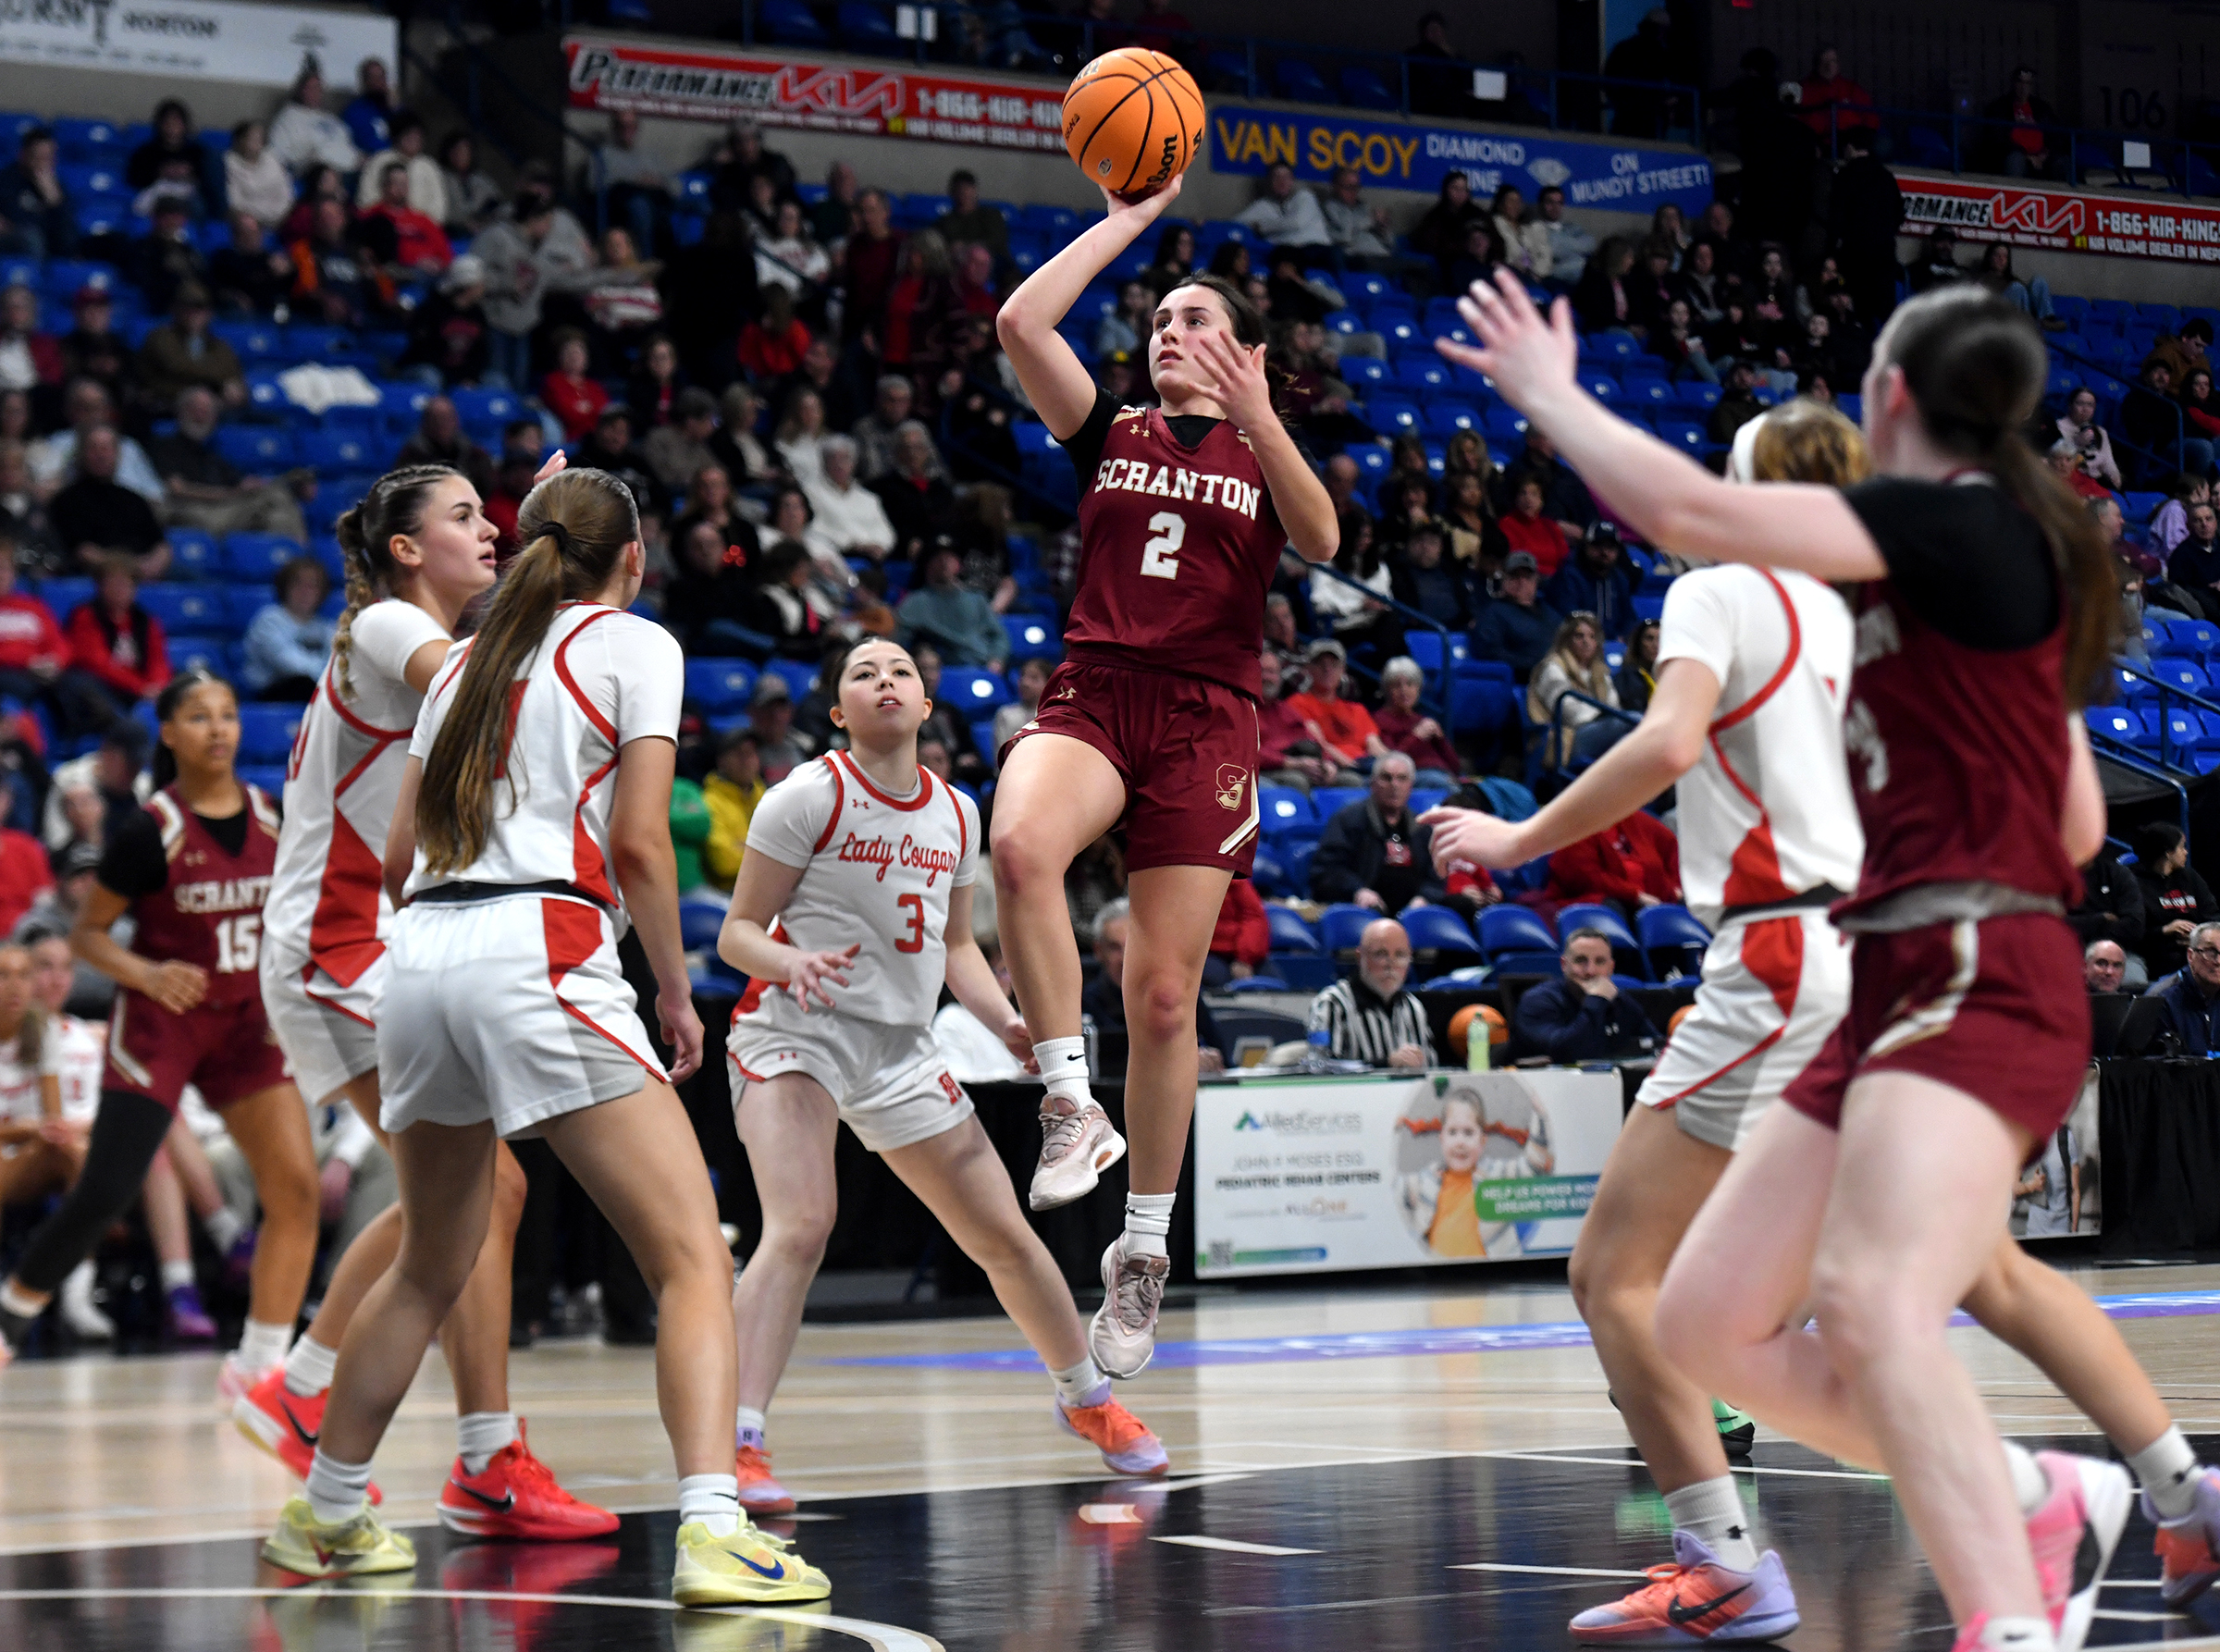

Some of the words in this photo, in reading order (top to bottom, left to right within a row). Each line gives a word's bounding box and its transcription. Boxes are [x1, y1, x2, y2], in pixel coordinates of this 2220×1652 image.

[2098, 85, 2165, 129] 106
[1215, 117, 1297, 166] VAN
[1308, 127, 1420, 179] SCOY
[1426, 134, 1525, 166] DIAMOND
[1611, 153, 1639, 176] ON
[1449, 166, 1501, 194] INE
[1572, 176, 1634, 203] MUNDY
[1094, 458, 1261, 521] SCRANTON
[1140, 511, 1187, 580] 2
[838, 832, 894, 882] Lady
[174, 874, 273, 914] SCRANT
[215, 914, 261, 973] 15
[894, 893, 924, 954] 3
